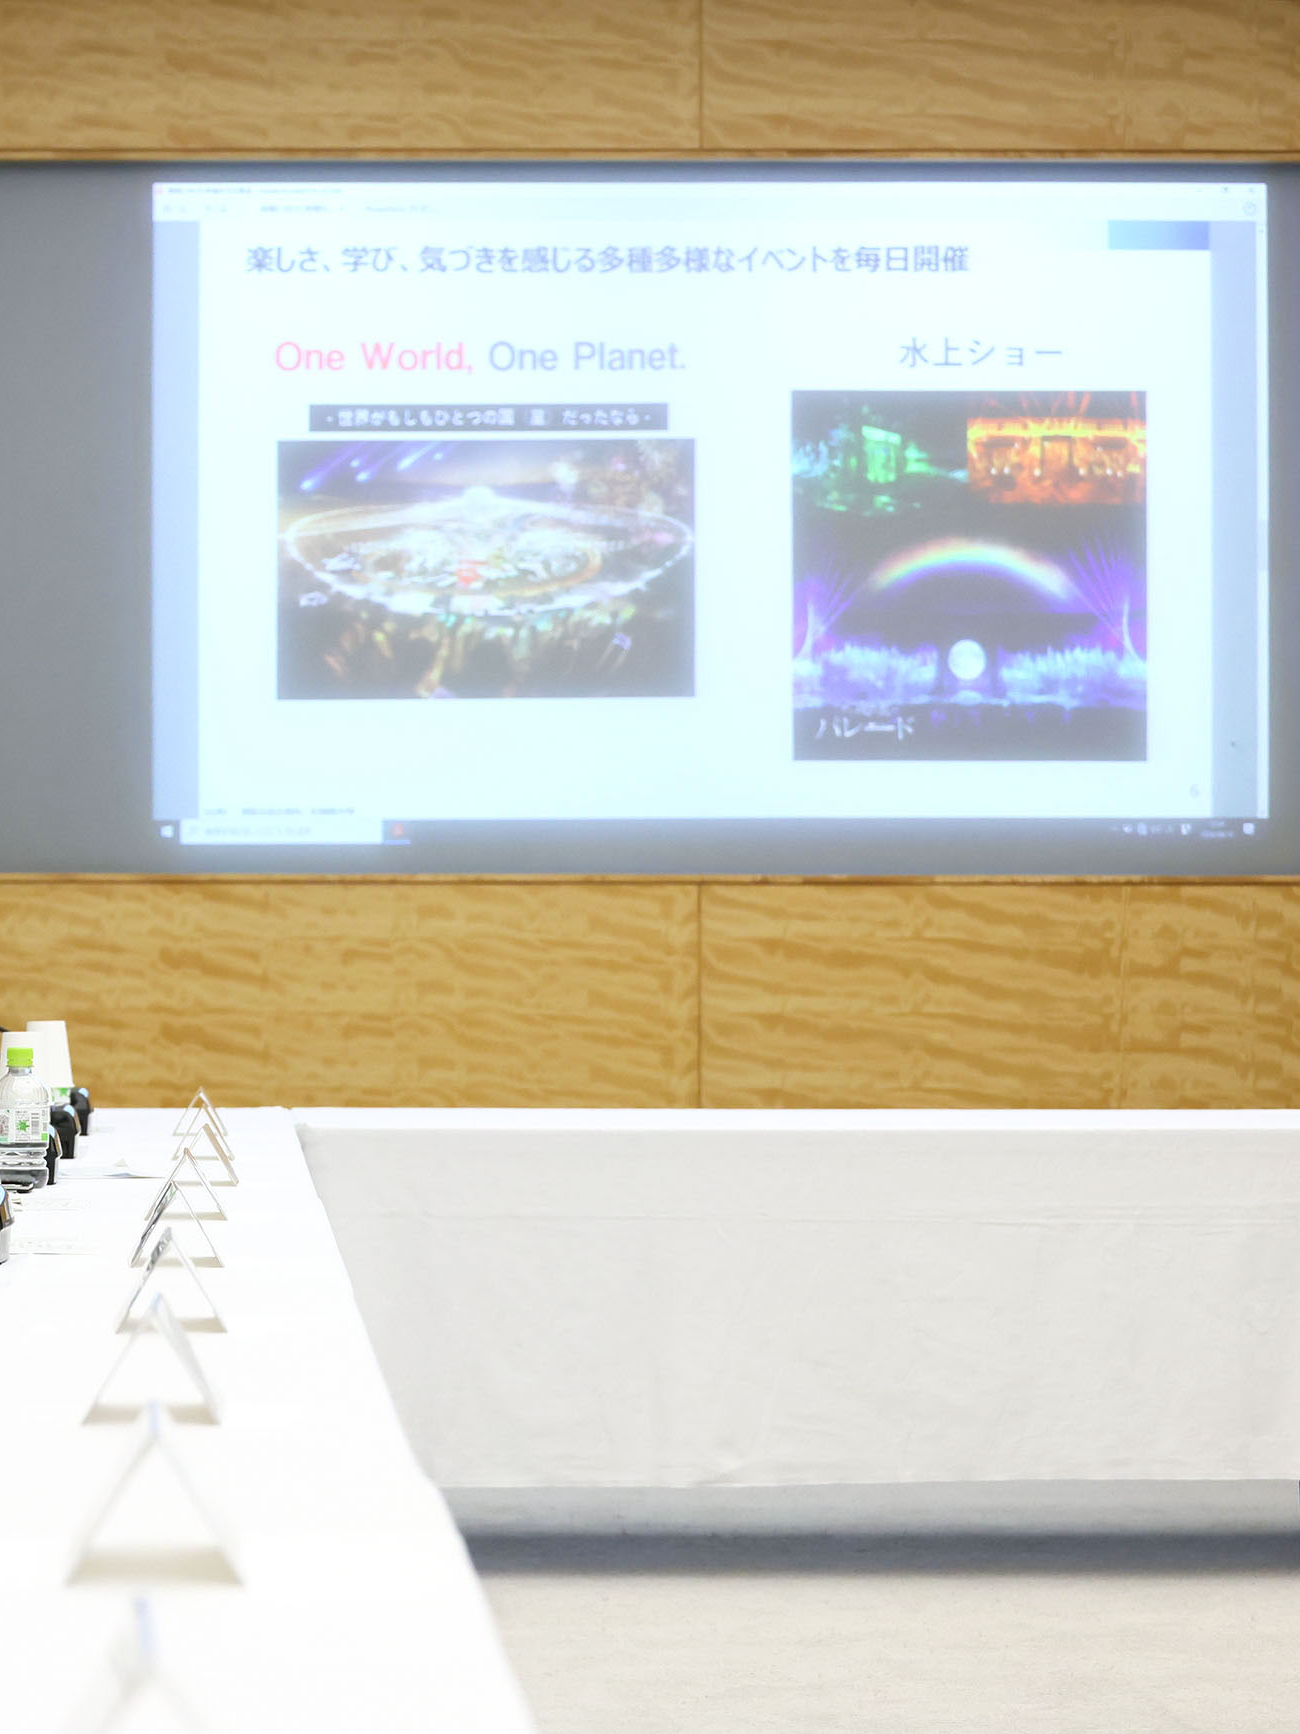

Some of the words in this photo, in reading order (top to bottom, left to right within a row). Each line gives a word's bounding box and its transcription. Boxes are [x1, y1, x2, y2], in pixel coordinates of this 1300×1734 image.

[247, 246, 970, 273] 楽しさ、学び、気づきを感じる多種多様なイベントを毎日開催
[275, 341, 345, 371] One
[360, 341, 473, 374] World,
[488, 341, 558, 371] One
[573, 341, 686, 371] Planet.
[899, 336, 1063, 367] 水上ショー
[814, 716, 915, 740] パレード
